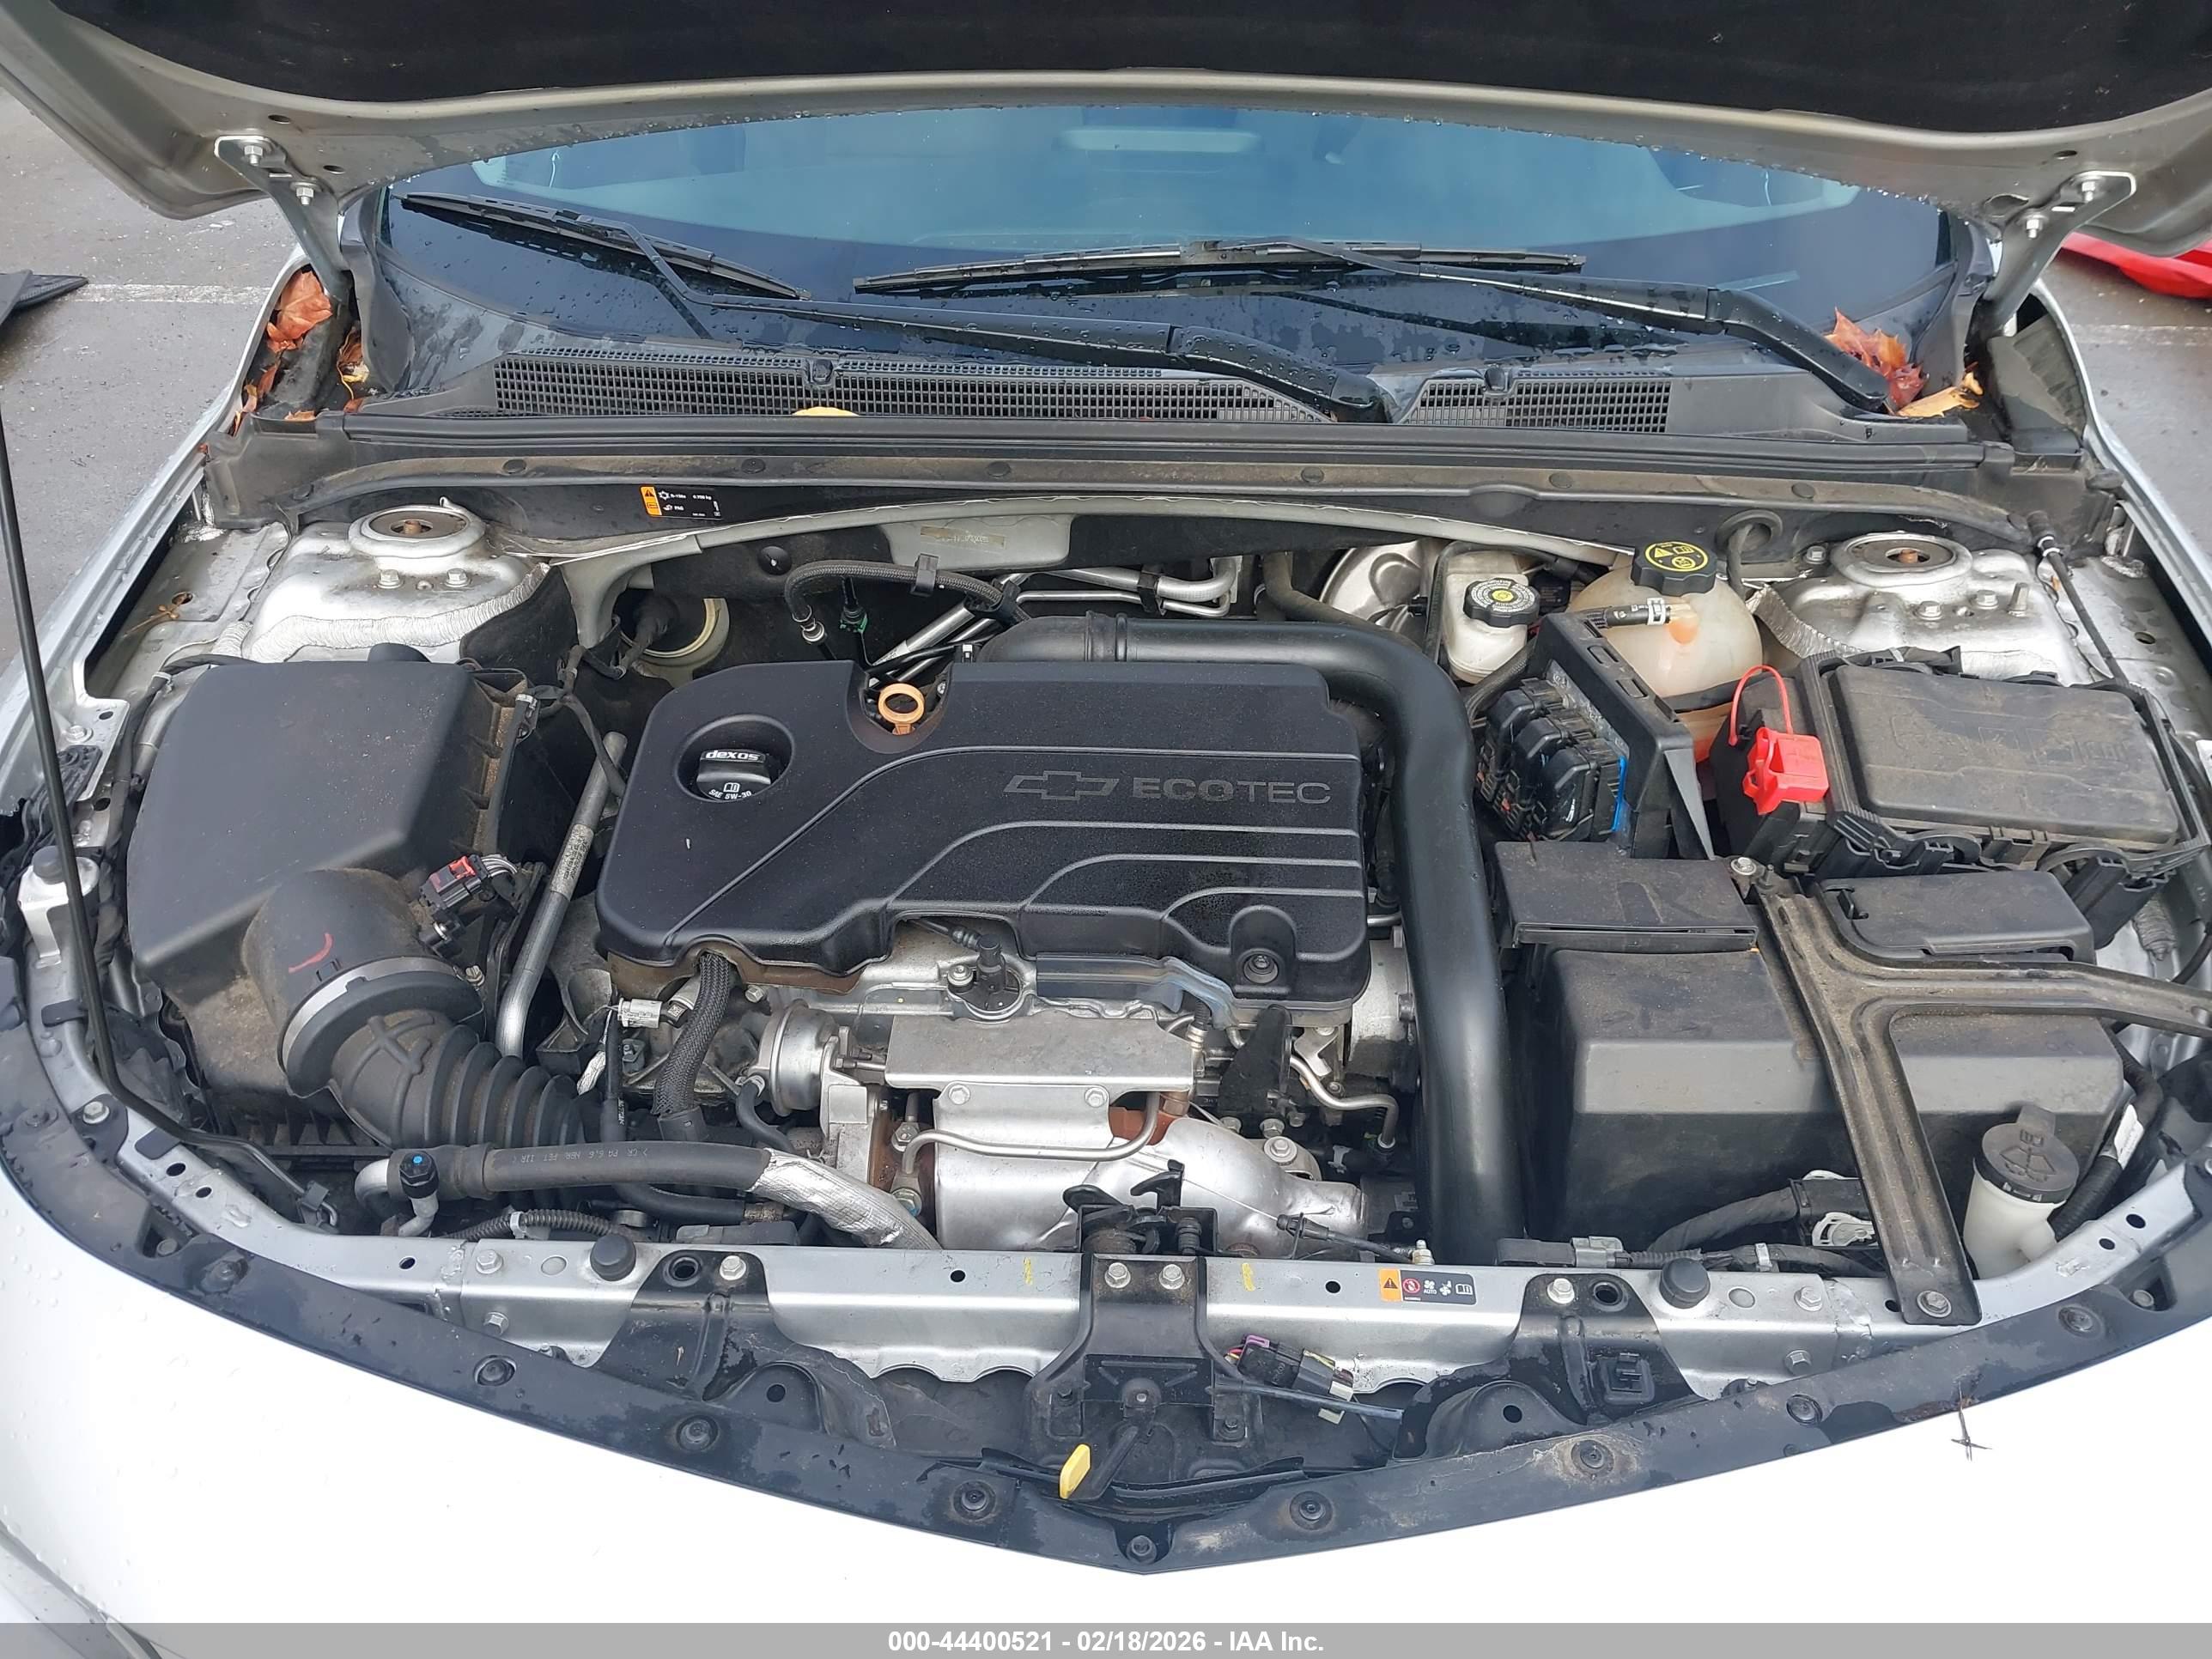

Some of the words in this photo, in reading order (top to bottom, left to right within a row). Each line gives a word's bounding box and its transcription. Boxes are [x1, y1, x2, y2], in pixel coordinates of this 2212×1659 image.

[705, 750, 760, 761] dexos
[708, 789, 723, 799] SAE
[724, 790, 752, 799] 5W-30
[1133, 777, 1331, 805] ECOTEC
[608, 1149, 618, 1158] PA
